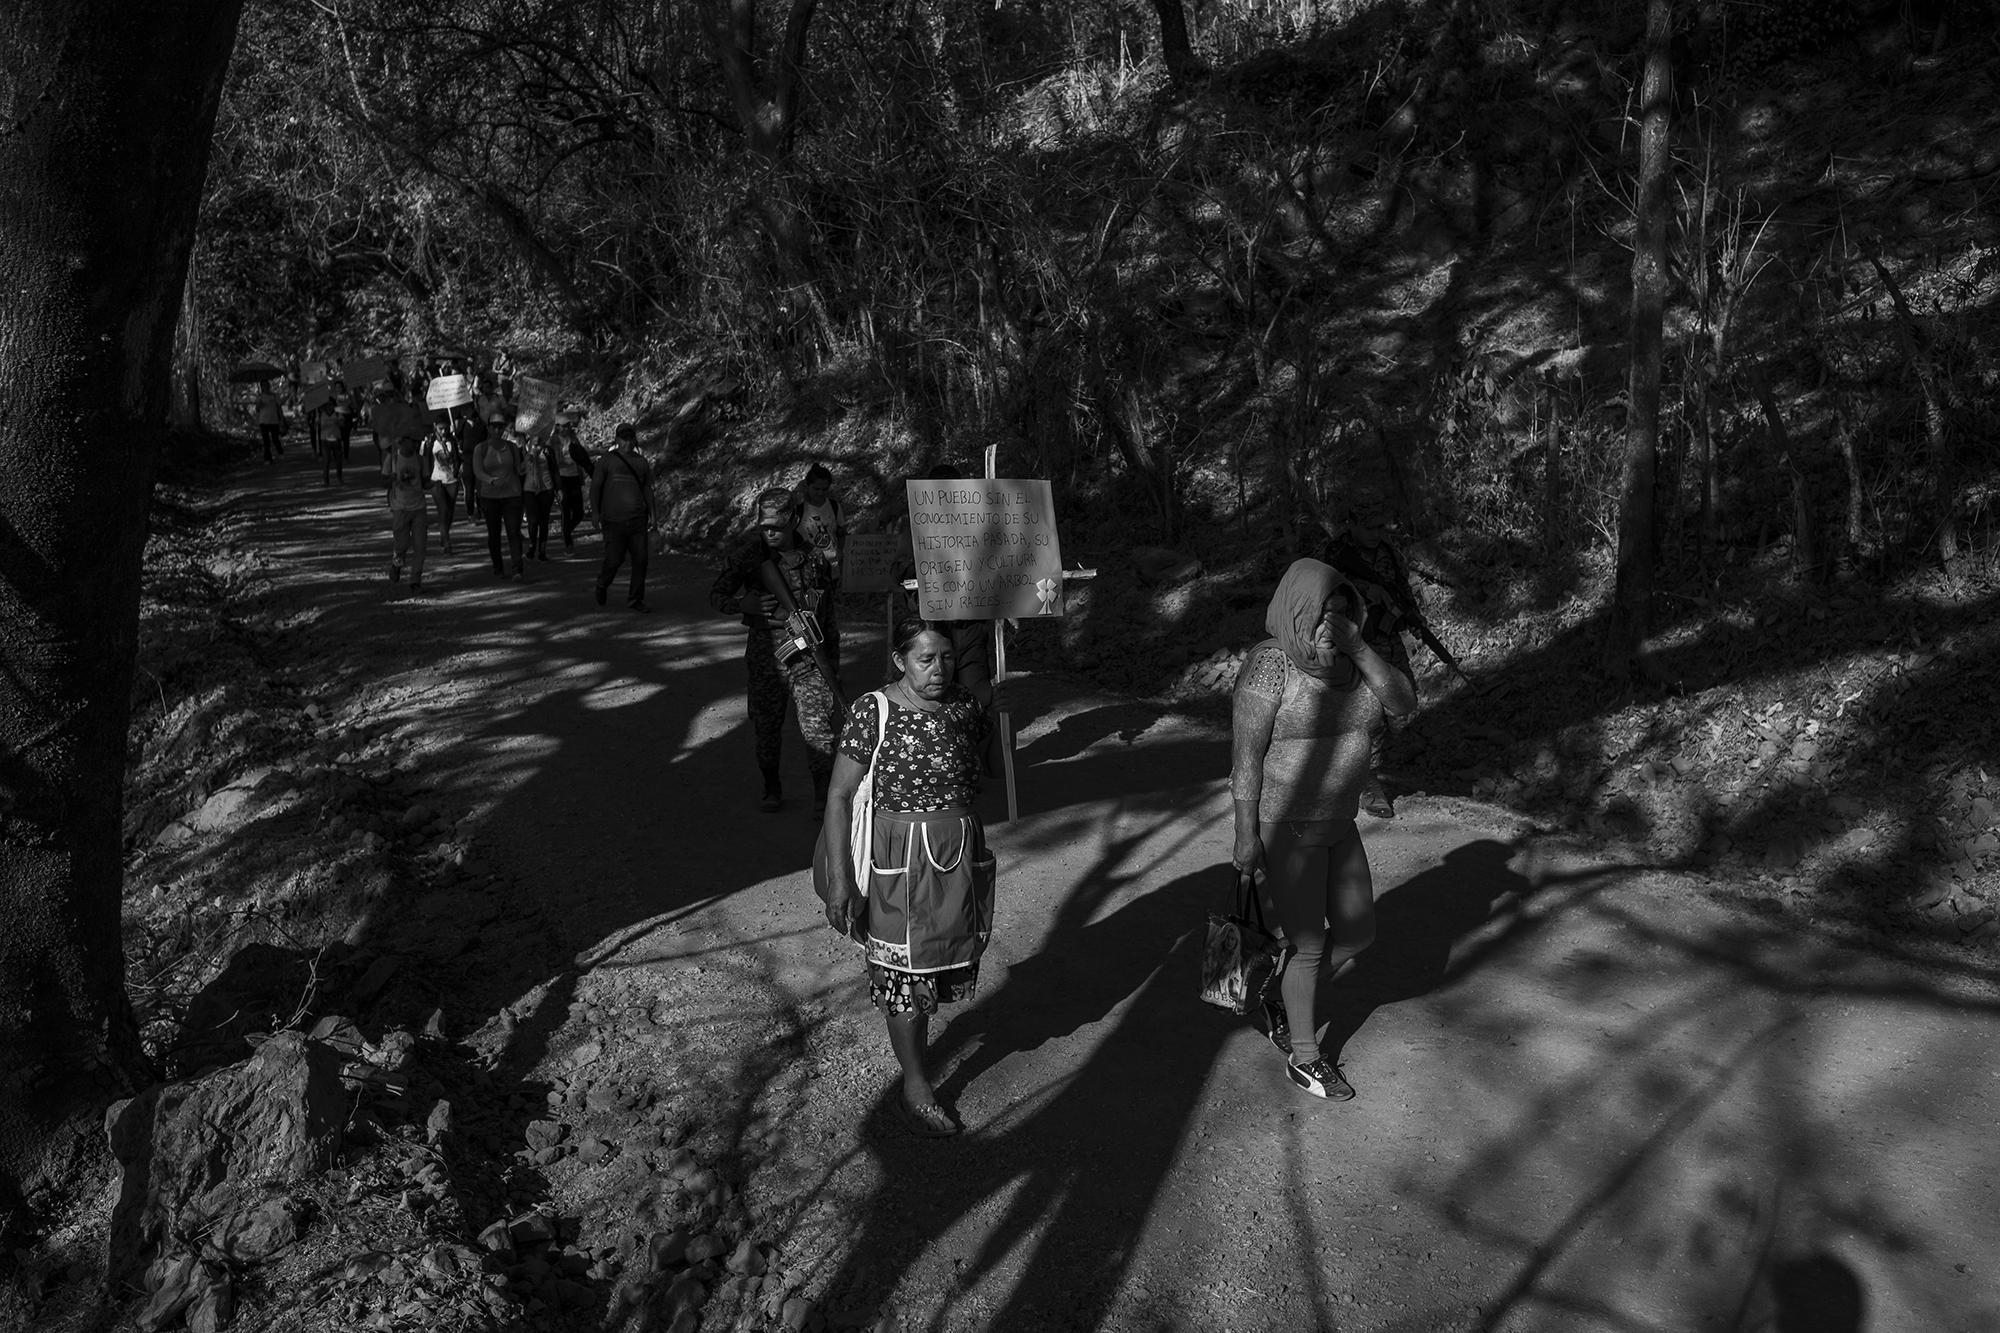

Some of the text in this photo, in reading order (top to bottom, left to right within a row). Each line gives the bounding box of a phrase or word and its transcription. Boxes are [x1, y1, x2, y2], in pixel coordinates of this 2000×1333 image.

[914, 489, 1032, 507] UN PUEBLO SIN EL
[913, 511, 1039, 525] CONOCIMIENTO DE SU
[917, 534, 980, 551] HISTORIA
[1034, 533, 1049, 547] SU
[919, 553, 1038, 576] ORIGEN Y CULTURA
[924, 574, 1036, 593] ES COMO UN ARBOL
[926, 598, 953, 614] SIN
